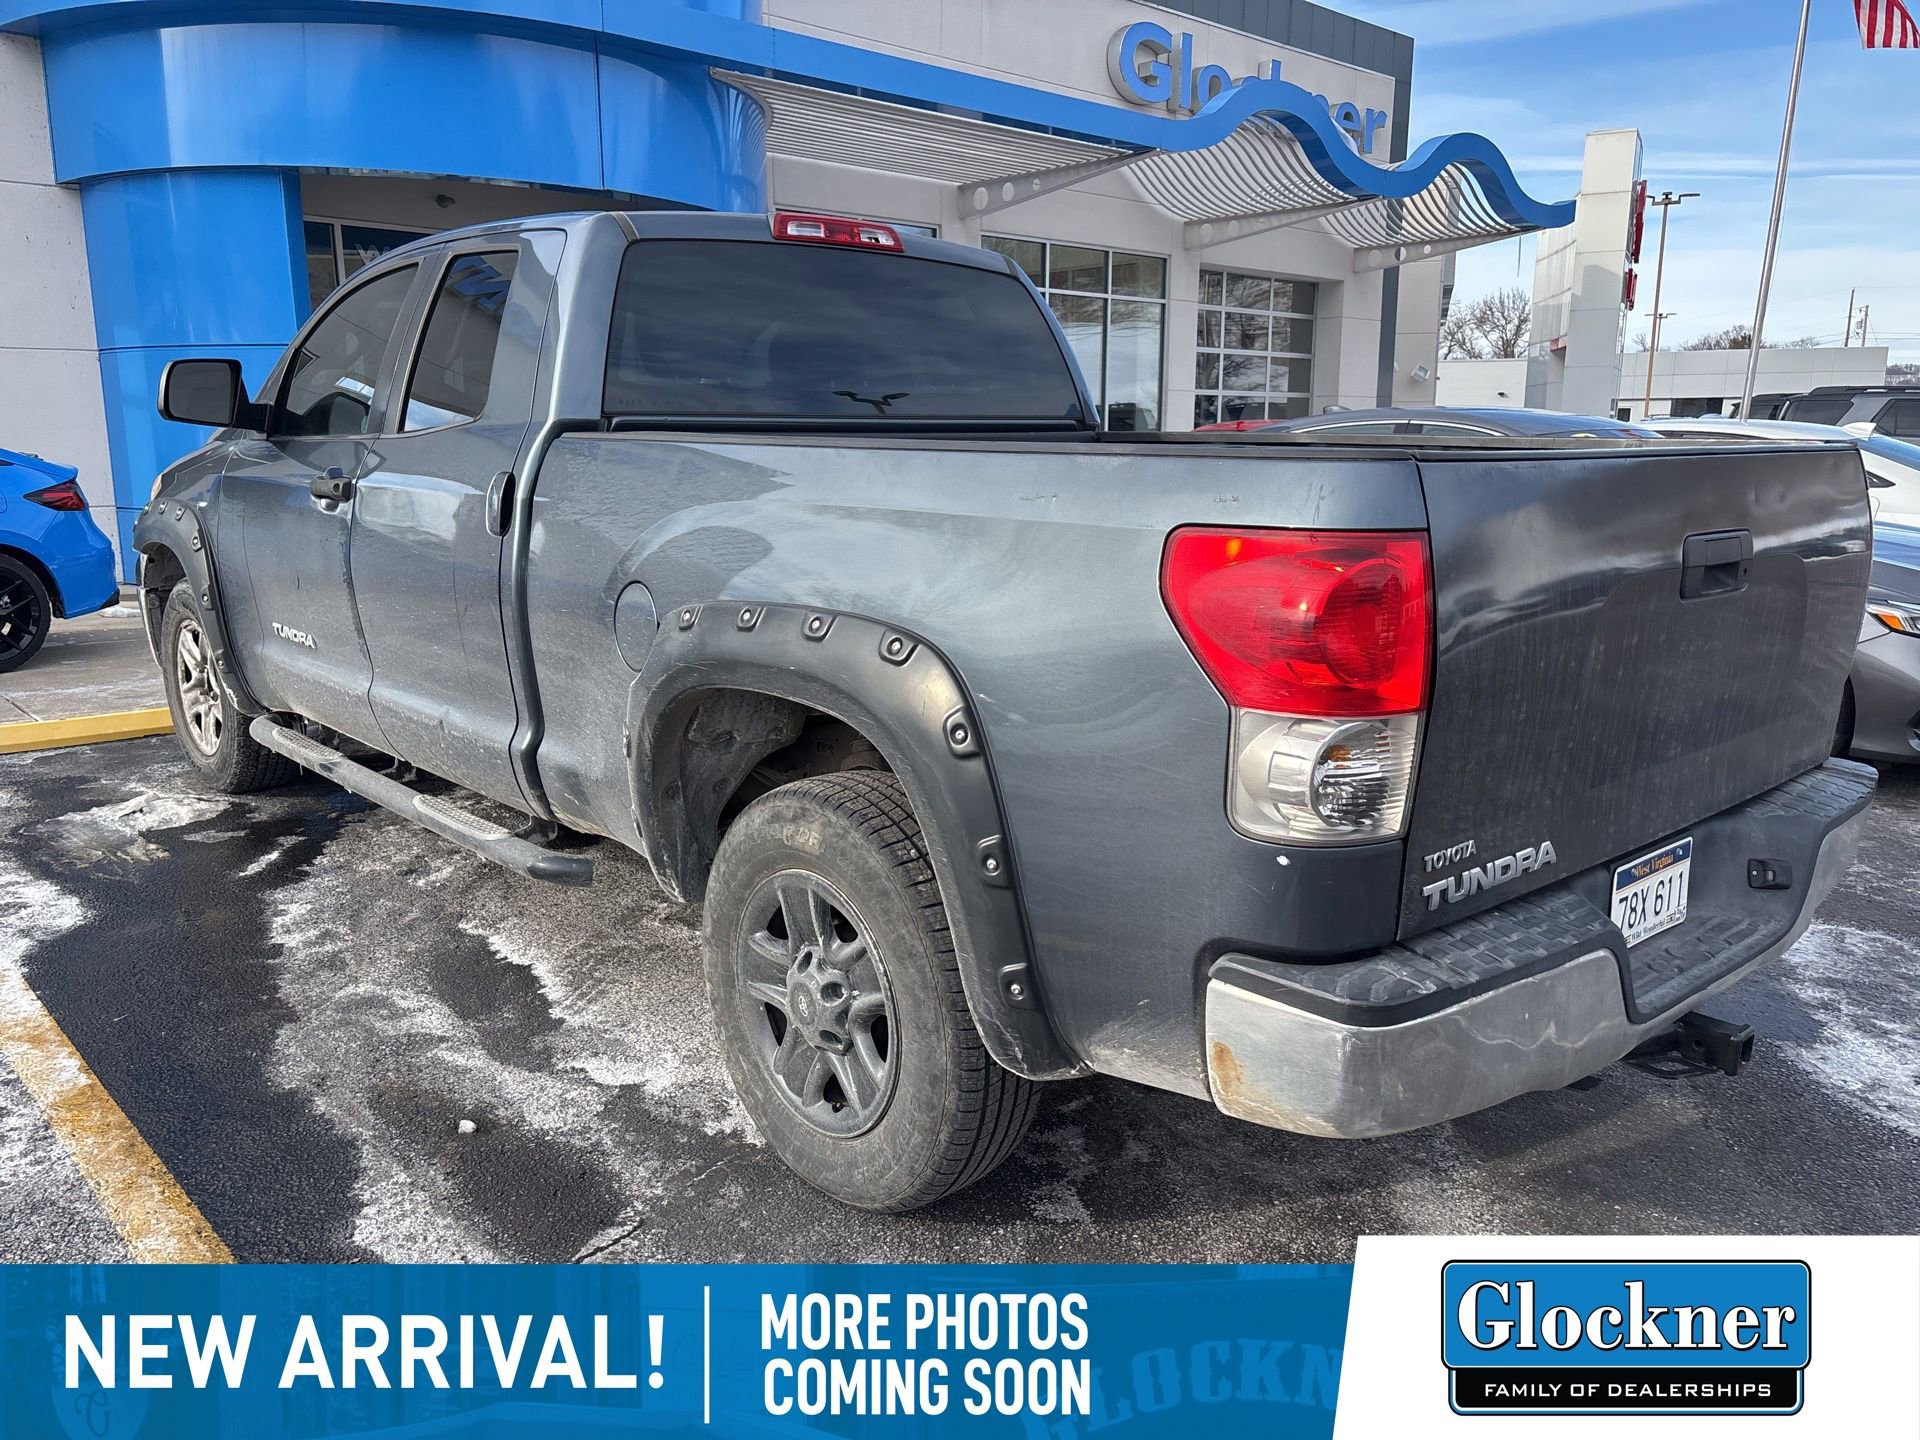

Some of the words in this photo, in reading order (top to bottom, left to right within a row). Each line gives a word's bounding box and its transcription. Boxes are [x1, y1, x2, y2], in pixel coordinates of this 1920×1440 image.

[271, 621, 317, 649] TUNDRA
[1423, 839, 1477, 872] TOYOTA
[1636, 863, 1650, 878] West
[1651, 853, 1674, 870] Virginia
[1421, 840, 1557, 911] TUNDRA
[1618, 886, 1650, 931] 78X
[1653, 869, 1684, 916] 611
